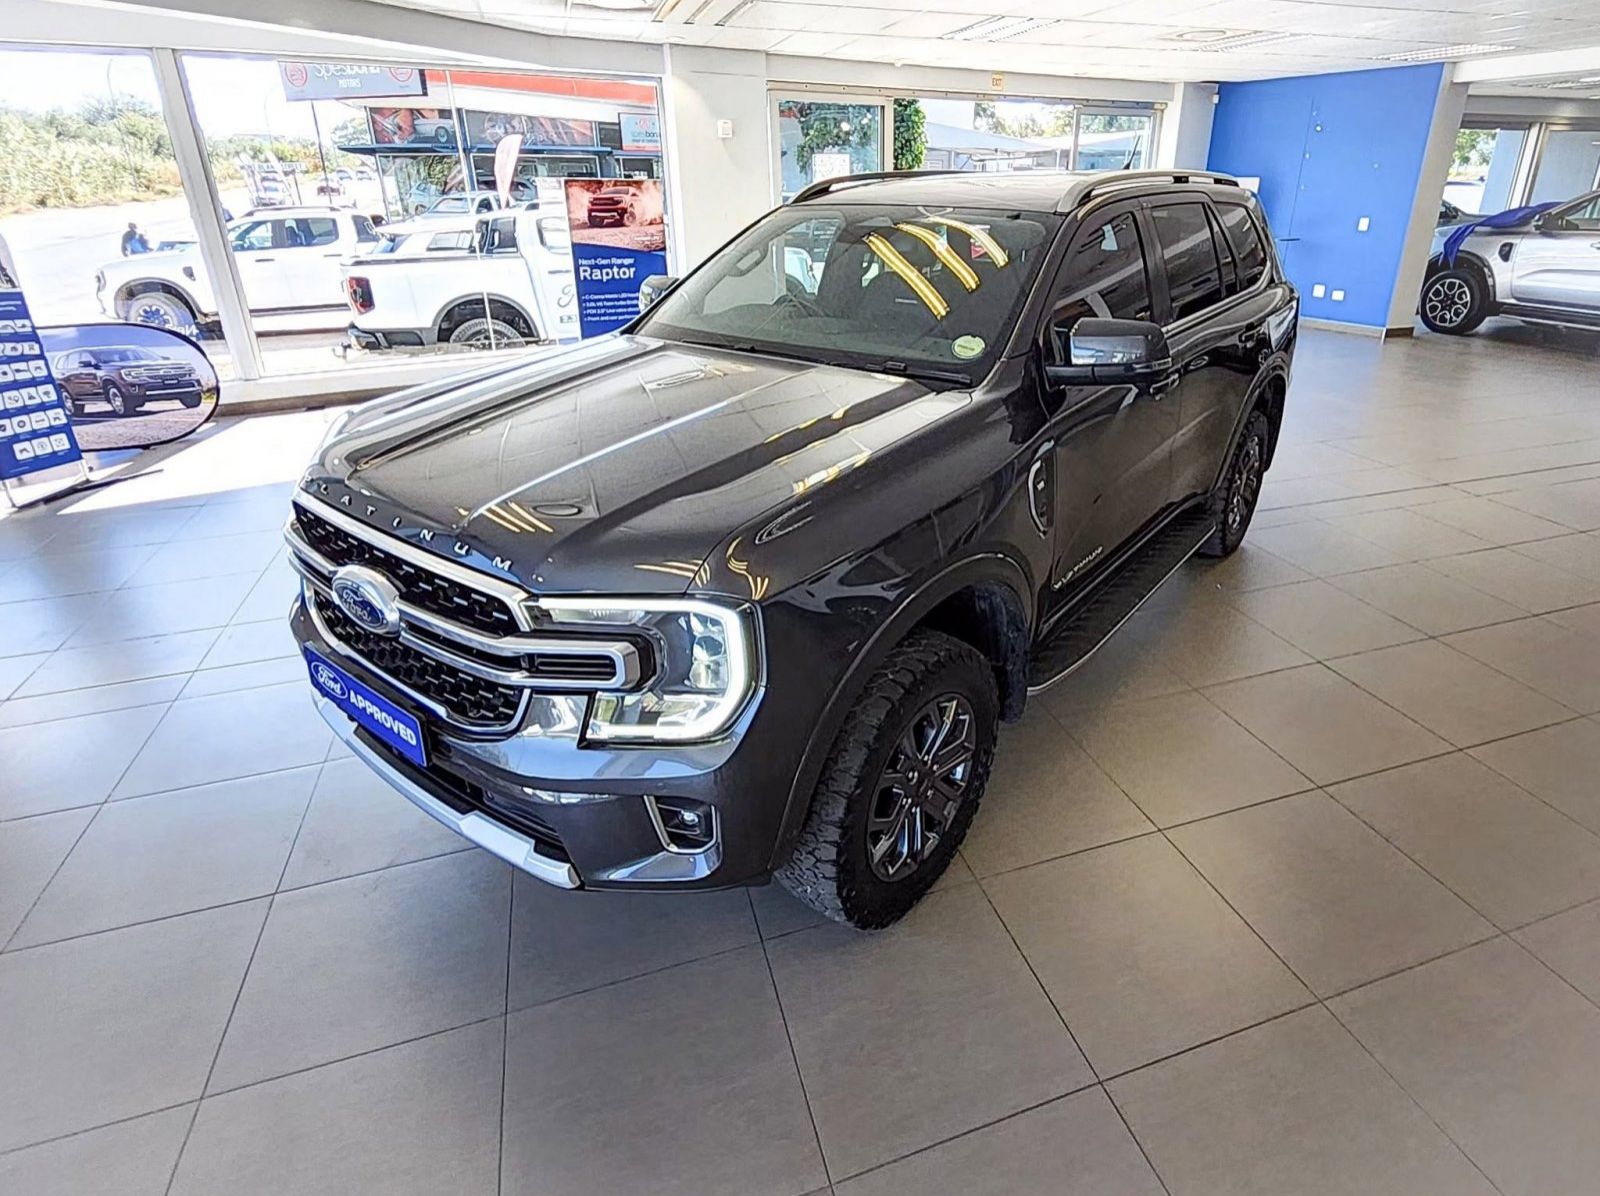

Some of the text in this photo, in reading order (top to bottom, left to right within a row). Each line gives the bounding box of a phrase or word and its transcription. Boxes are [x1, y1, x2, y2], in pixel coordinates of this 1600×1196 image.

[579, 265, 636, 282] Raptor
[611, 257, 635, 265] Ranger
[304, 475, 514, 572] PLATINUM
[342, 588, 373, 622] Ford
[318, 665, 417, 747] Ford APPROVED
